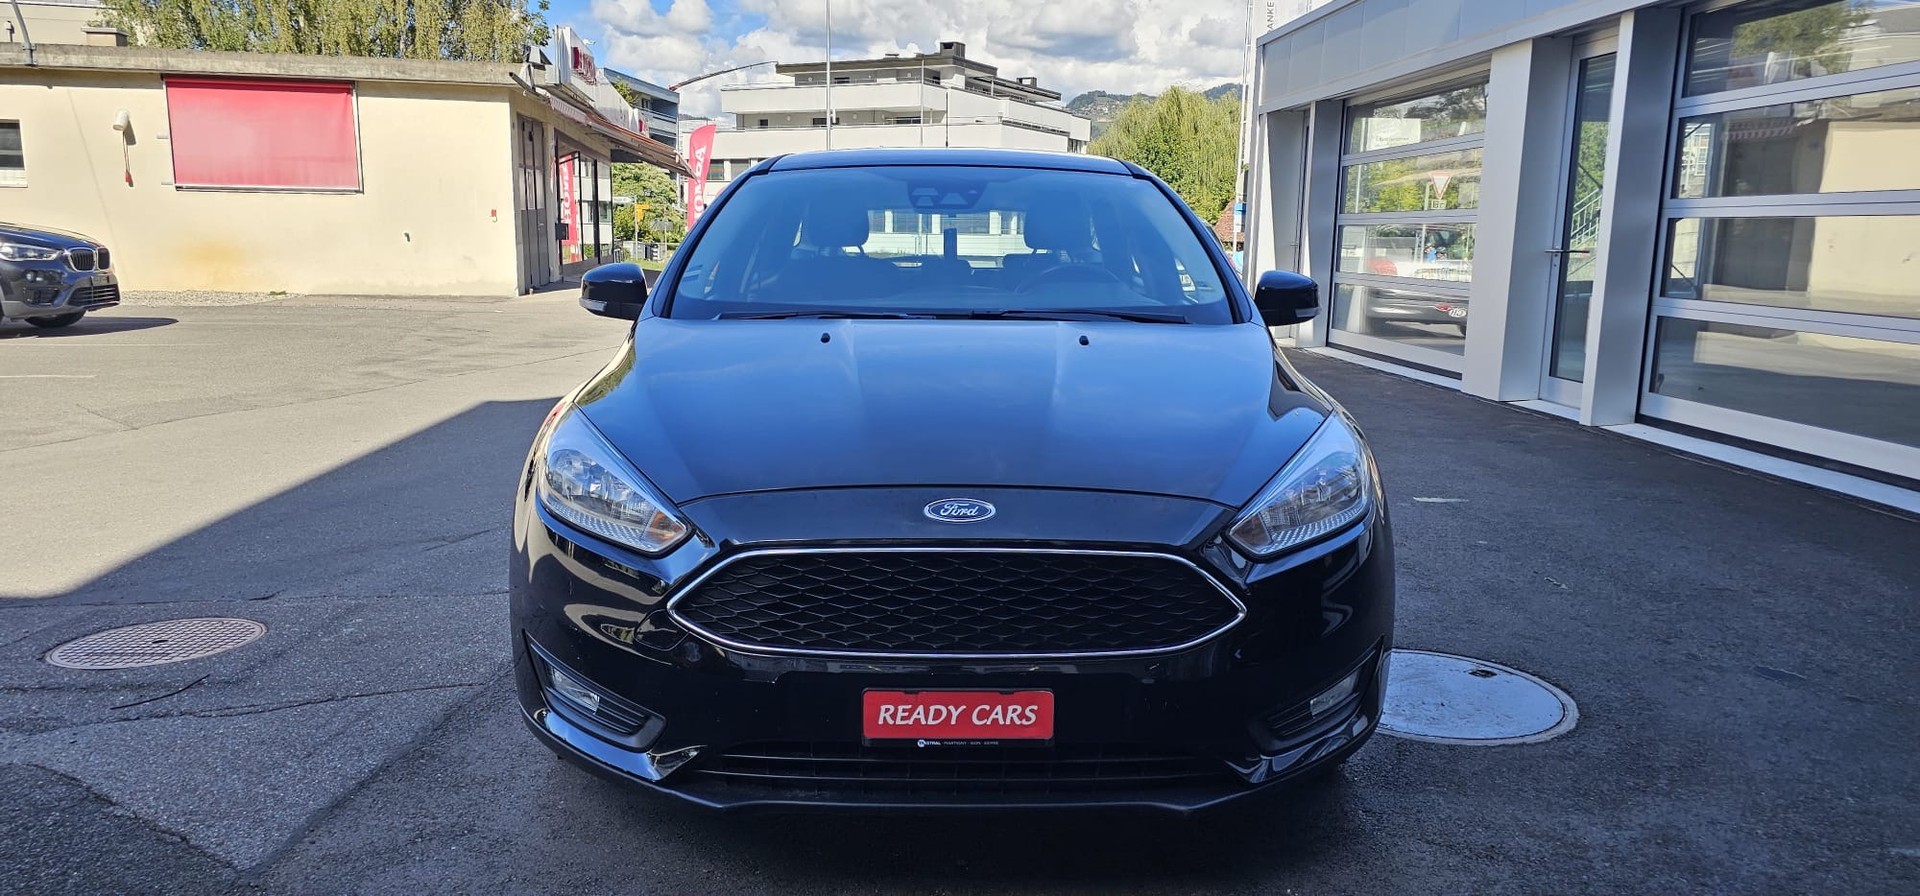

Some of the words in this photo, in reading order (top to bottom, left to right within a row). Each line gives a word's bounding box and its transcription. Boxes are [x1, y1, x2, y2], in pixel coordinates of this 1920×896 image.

[1266, 1, 1275, 34] ANKE
[940, 502, 979, 516] Ford
[878, 704, 967, 726] READY
[971, 704, 1039, 726] CARS
